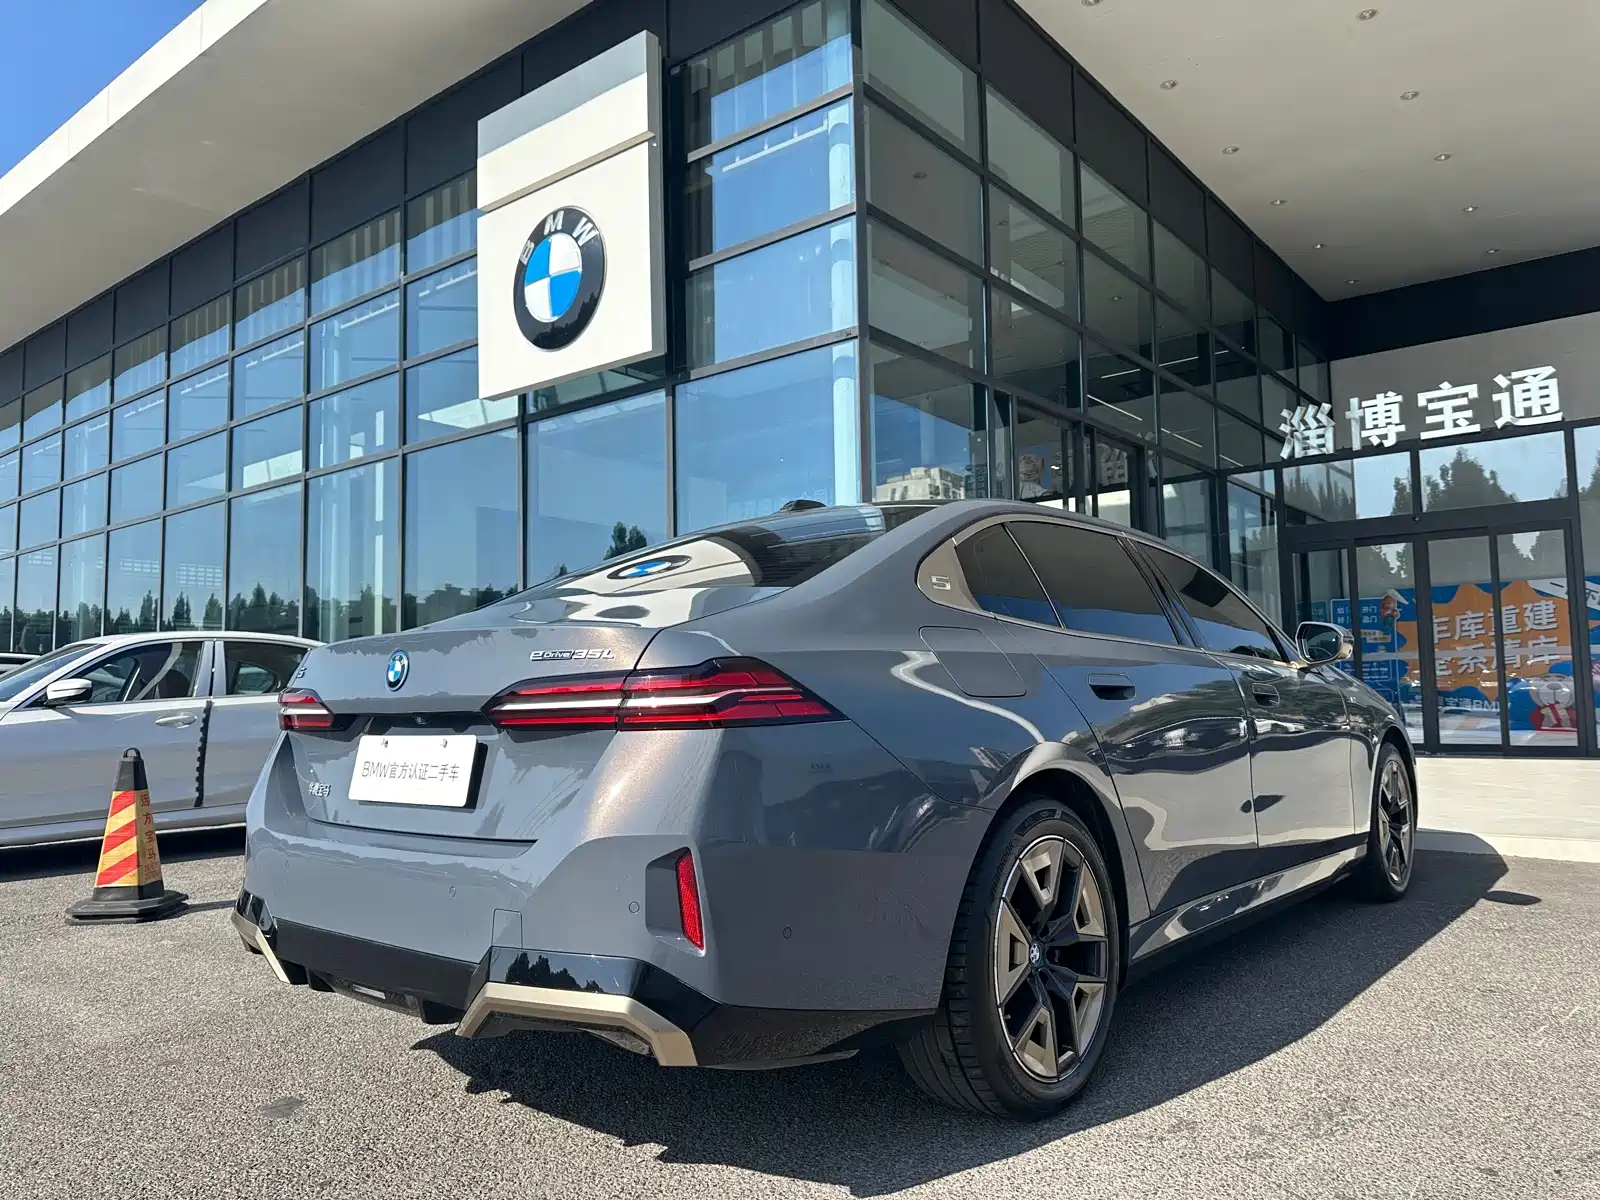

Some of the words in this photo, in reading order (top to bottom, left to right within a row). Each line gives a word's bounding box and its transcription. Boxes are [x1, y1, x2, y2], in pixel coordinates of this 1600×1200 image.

[519, 210, 600, 266] BMW
[1279, 365, 1563, 460] 淄博宝通
[931, 575, 951, 591] 5
[361, 761, 461, 782] BMW官方认证二手车
